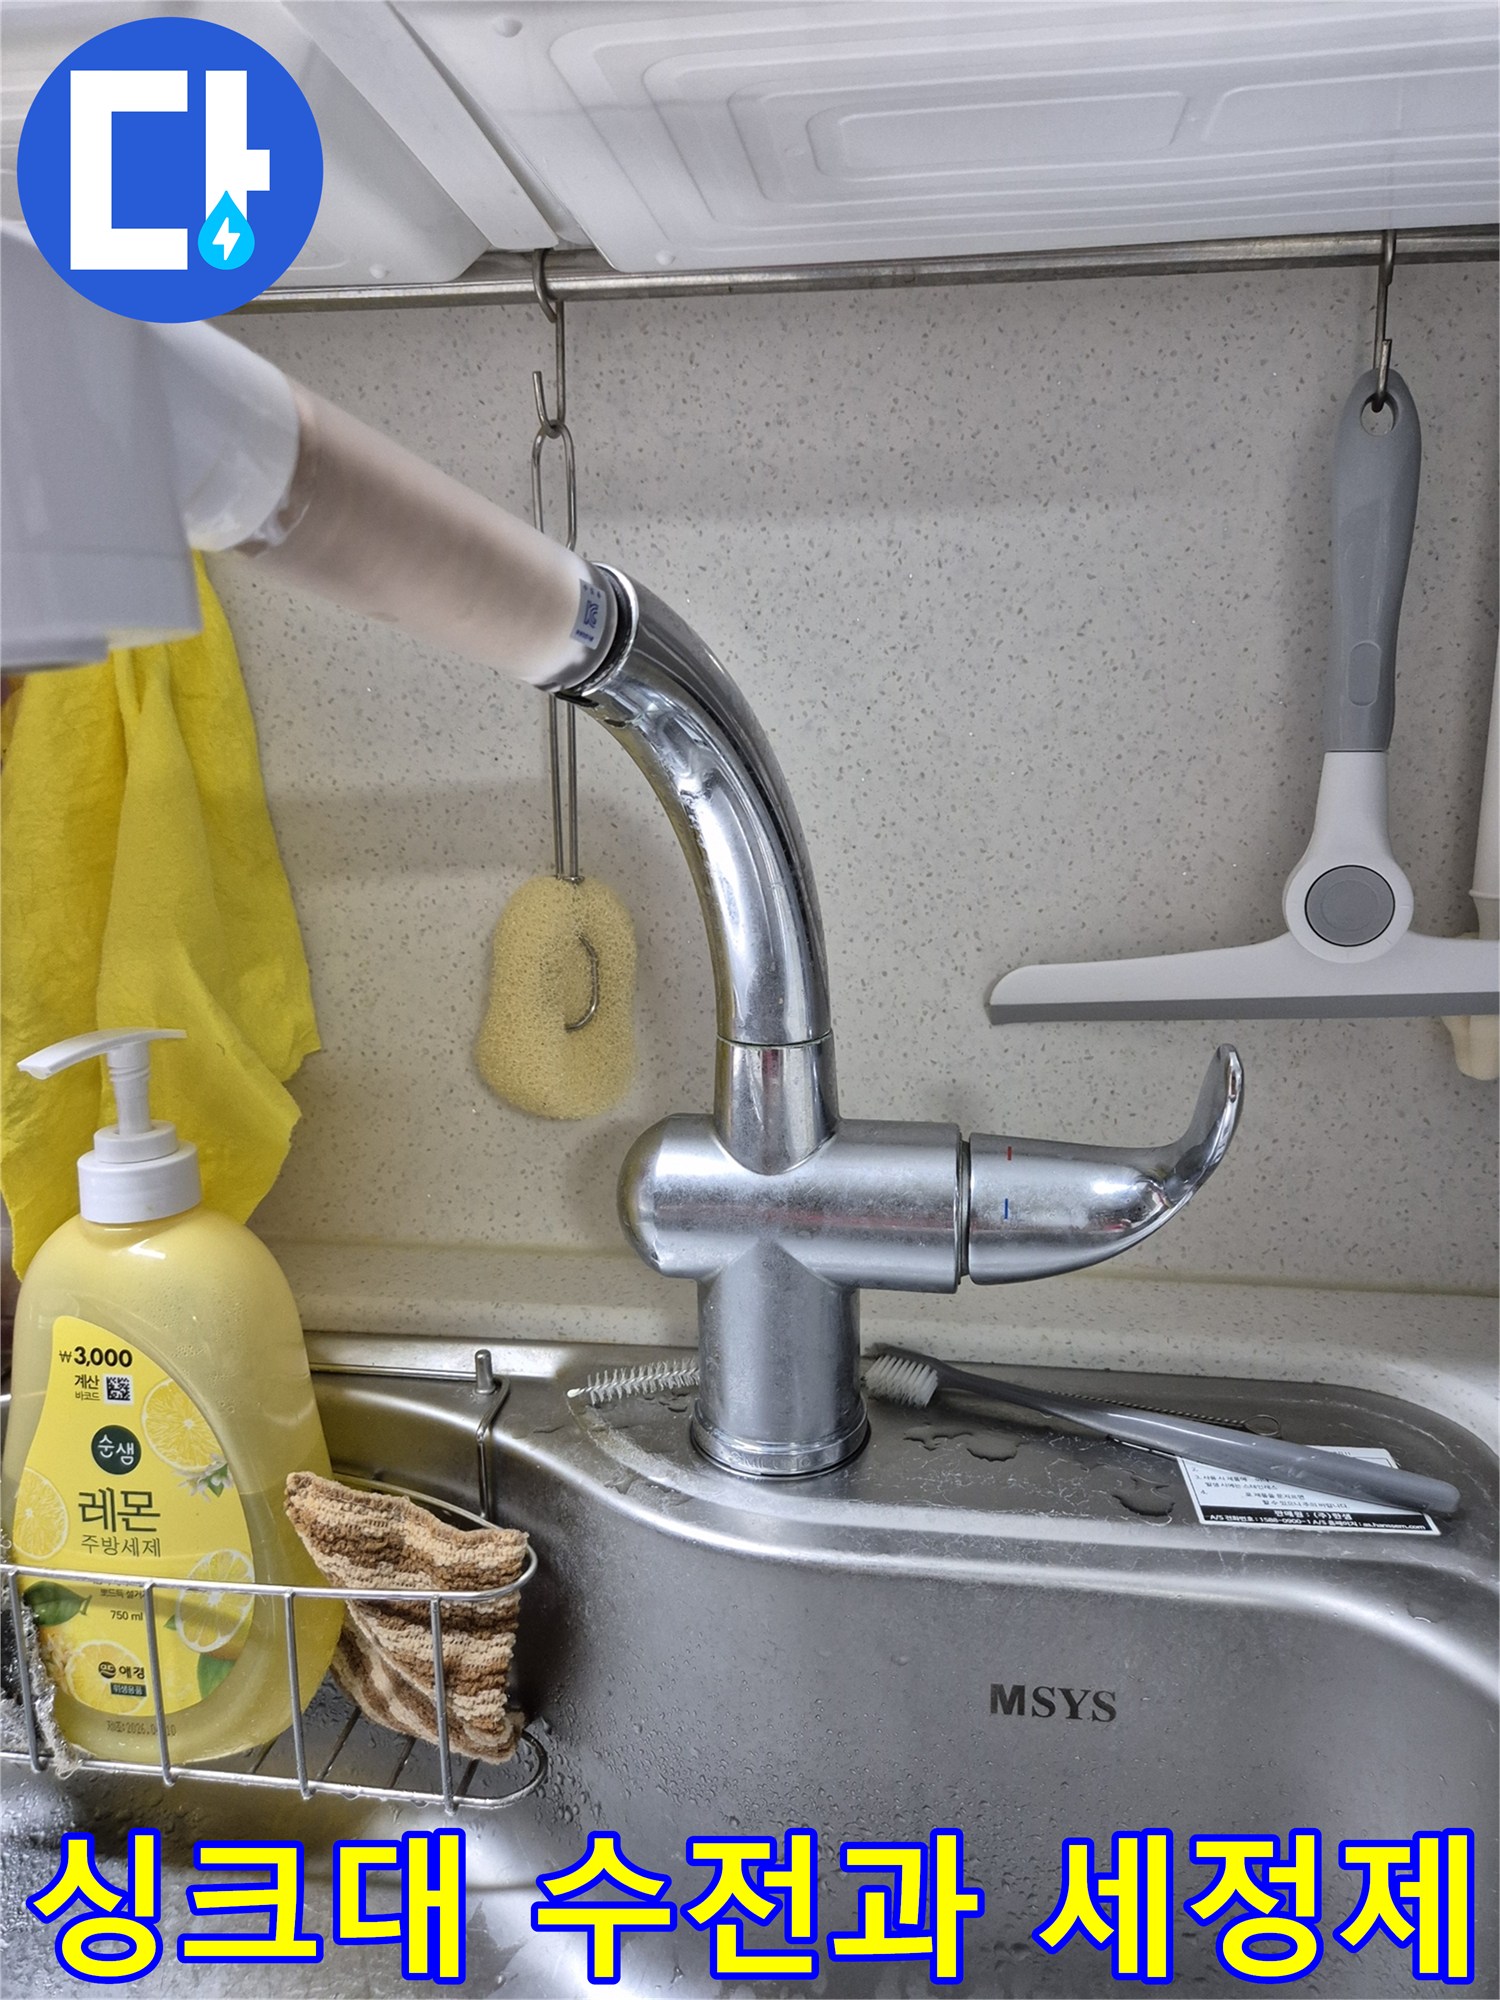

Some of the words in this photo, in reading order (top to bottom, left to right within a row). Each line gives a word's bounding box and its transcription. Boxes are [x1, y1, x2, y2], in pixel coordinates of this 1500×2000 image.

[75, 1374, 100, 1390] 계산
[75, 1391, 101, 1401] 바코드
[98, 1434, 134, 1465] 순샘
[78, 1487, 161, 1532] 레몬
[81, 1534, 161, 1557] 주방세제
[110, 1610, 129, 1621] 750
[131, 1612, 144, 1621] ml
[118, 1666, 145, 1680] 애경
[990, 1683, 1117, 1723] MSYS
